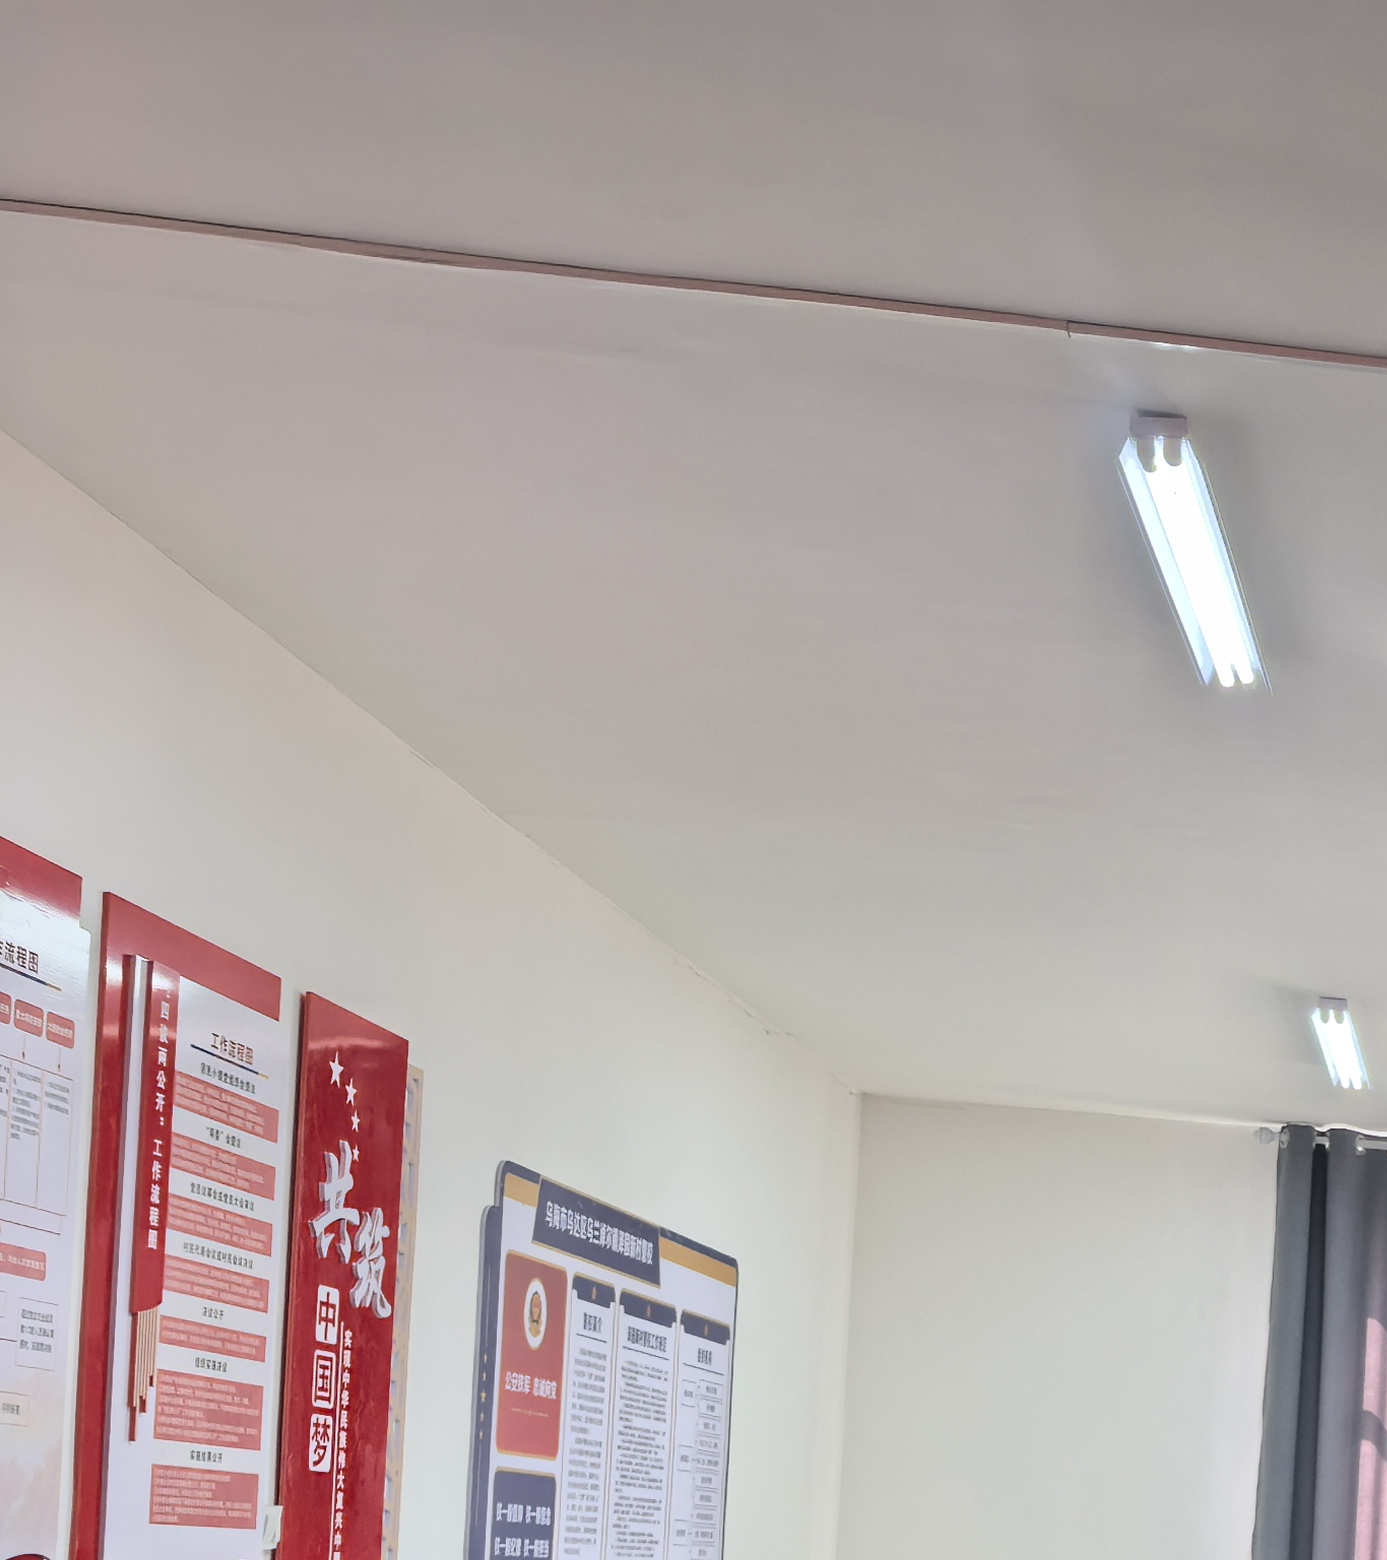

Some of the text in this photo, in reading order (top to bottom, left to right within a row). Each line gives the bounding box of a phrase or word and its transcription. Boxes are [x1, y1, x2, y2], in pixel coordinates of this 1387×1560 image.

[211, 1032, 254, 1066] 工作流程图
[308, 1139, 392, 1319] 共筑
[310, 1287, 339, 1470] 中国梦
